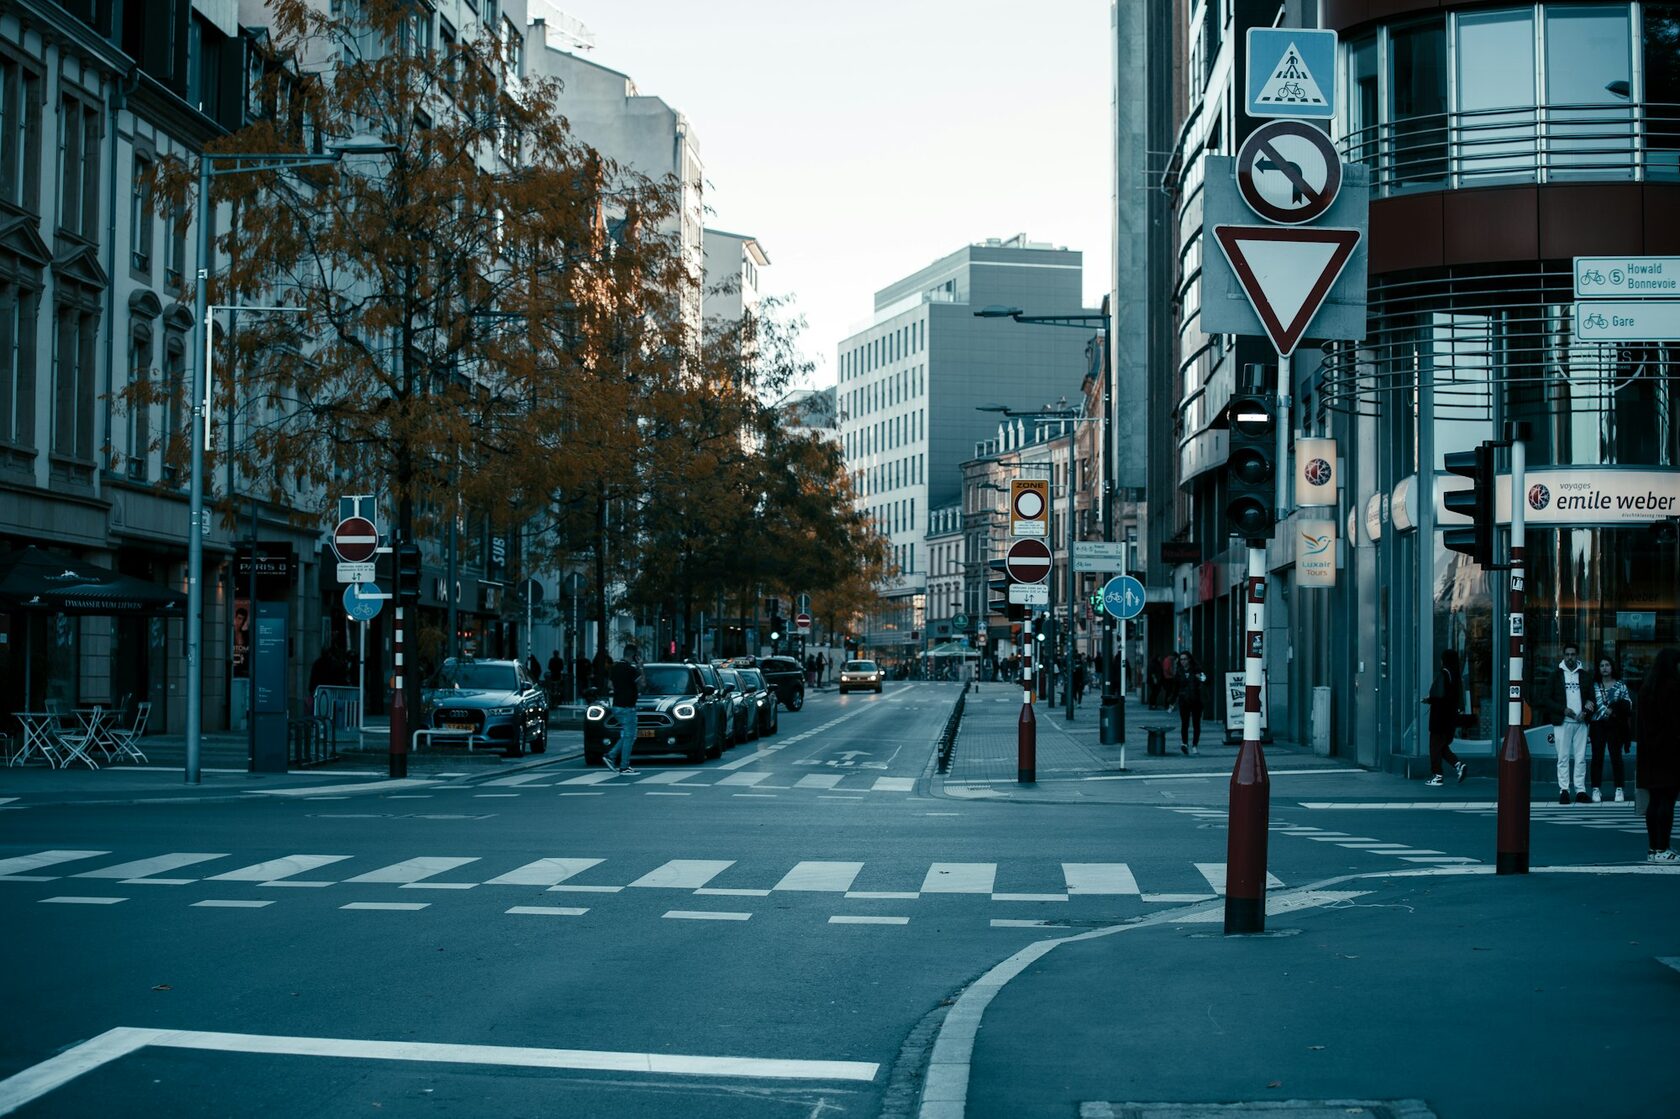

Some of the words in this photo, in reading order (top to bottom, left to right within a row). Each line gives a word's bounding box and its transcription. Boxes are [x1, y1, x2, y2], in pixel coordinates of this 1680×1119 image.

[1613, 272, 1621, 282] 5
[1627, 263, 1662, 274] Howald
[1628, 278, 1676, 289] Bonnevoie
[1612, 316, 1635, 326] Gare
[1560, 483, 1591, 491] voyages
[1557, 491, 1612, 510] emile
[1616, 491, 1676, 510] weber
